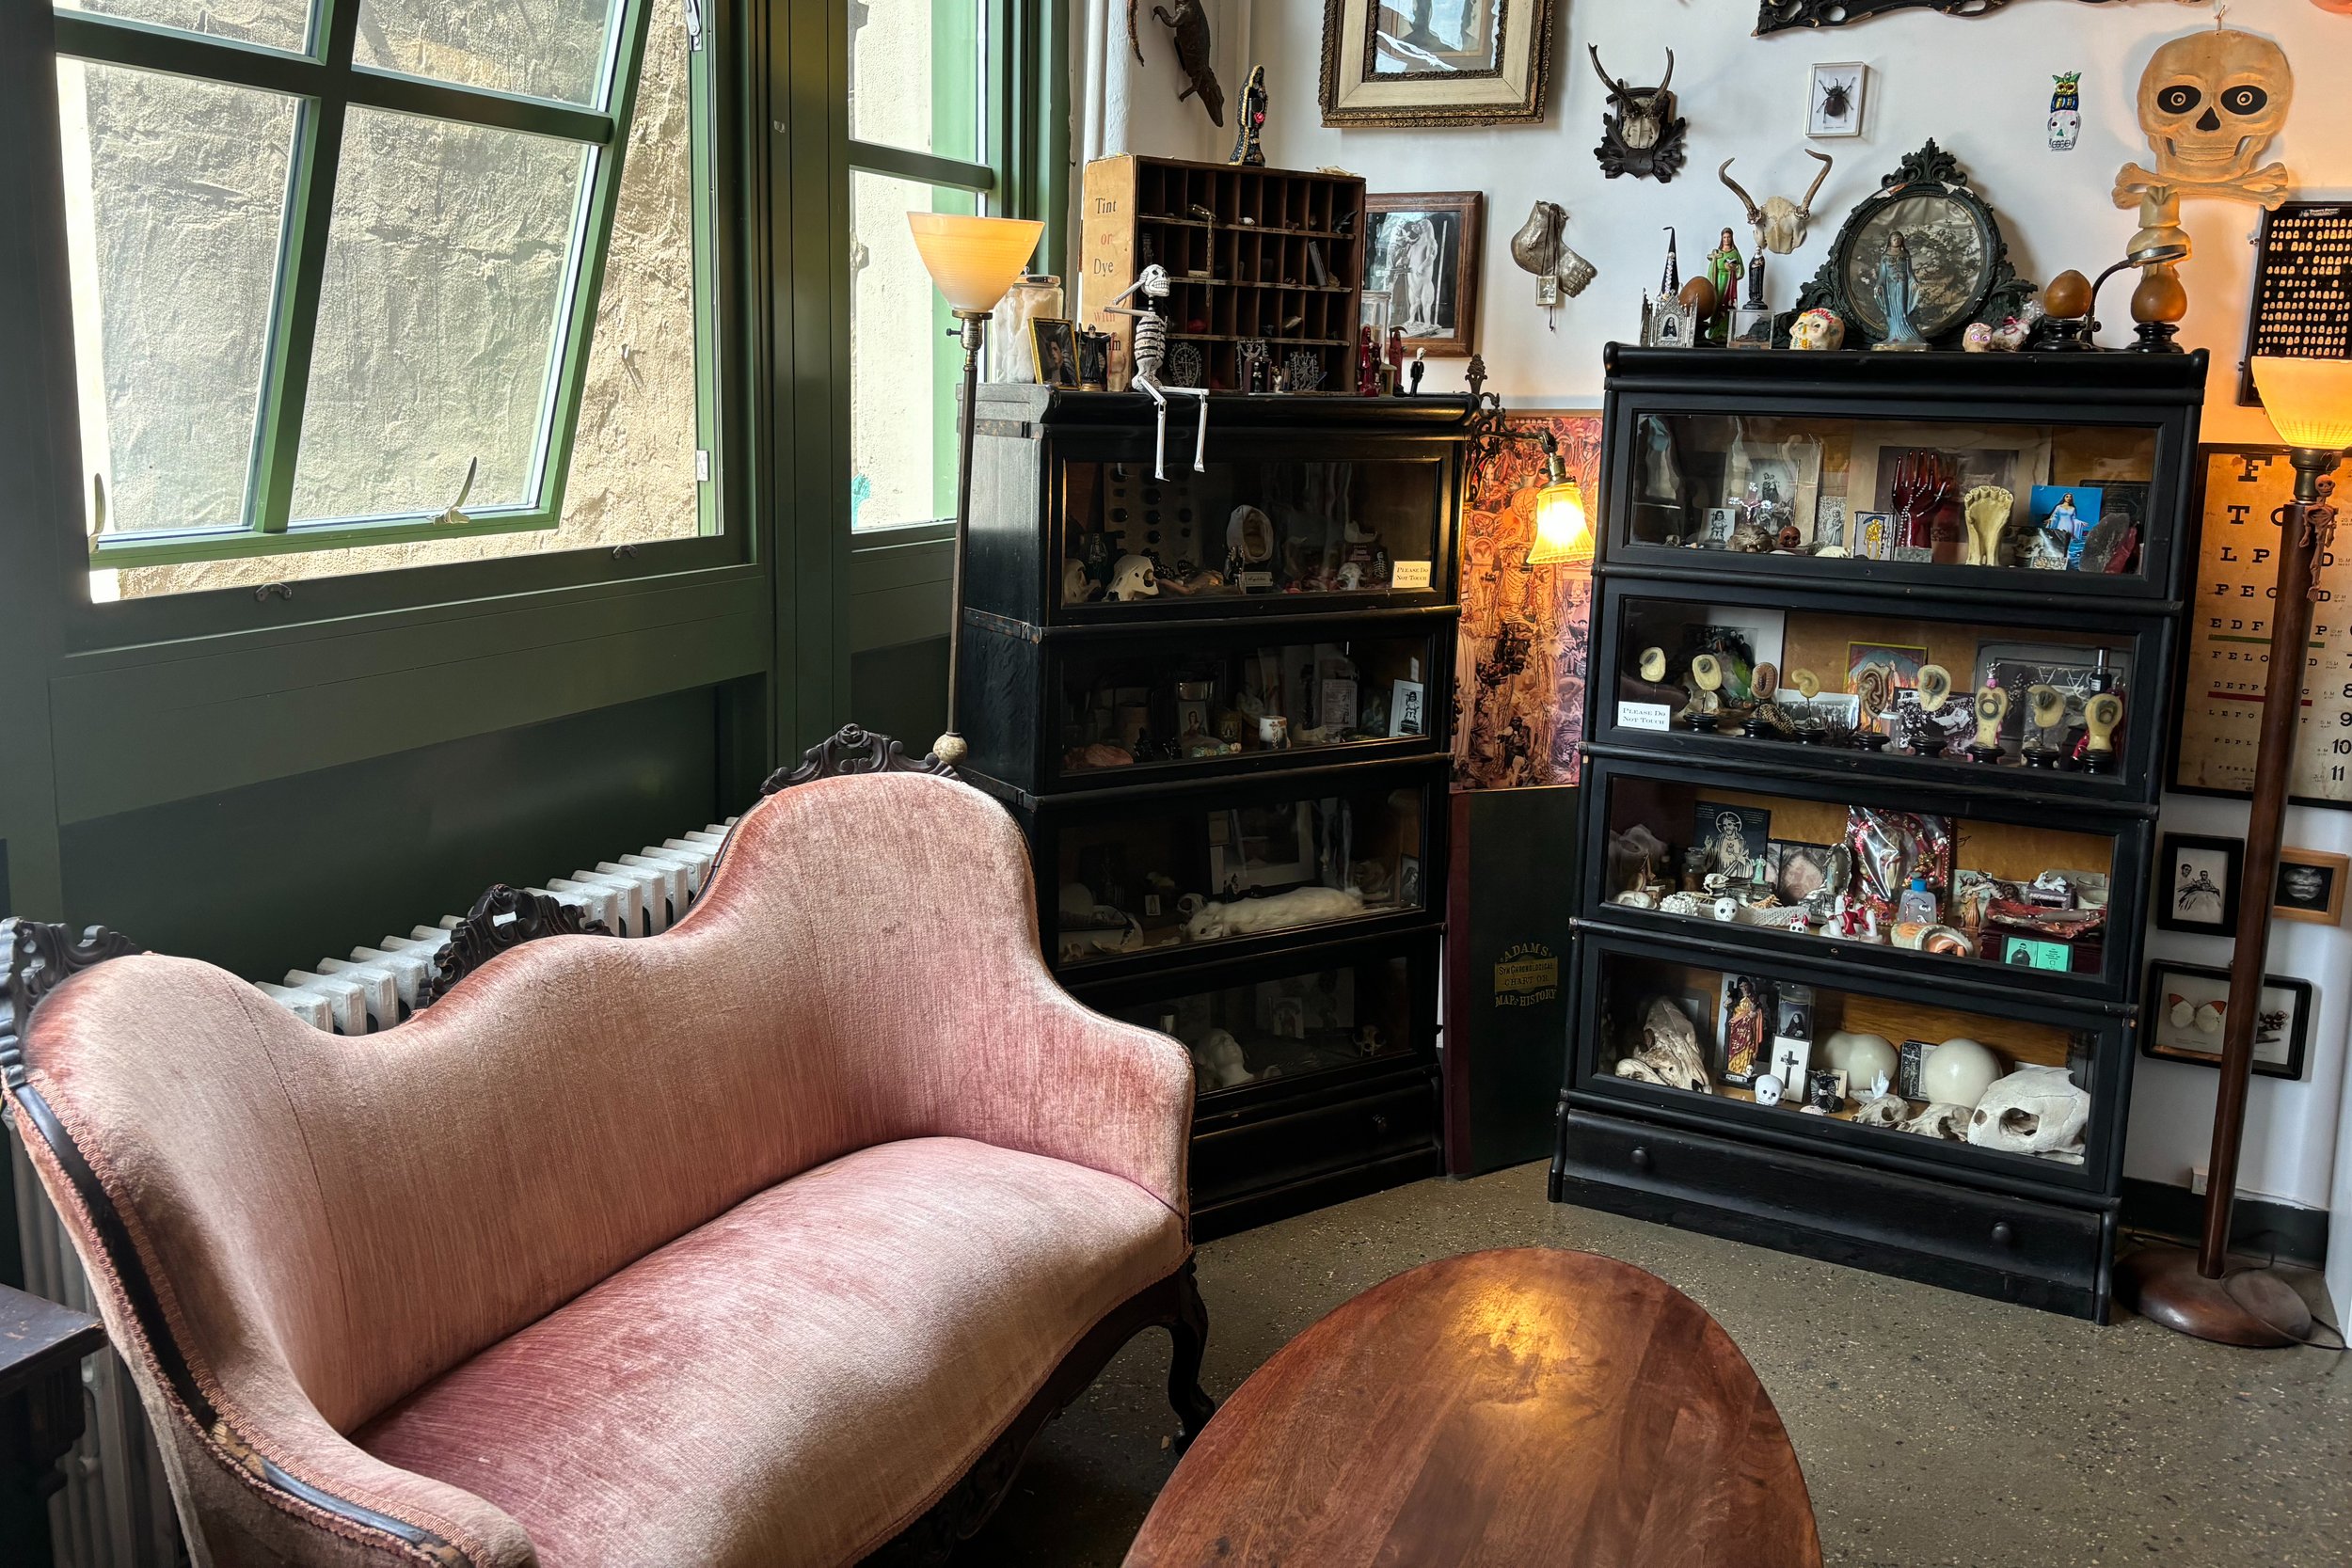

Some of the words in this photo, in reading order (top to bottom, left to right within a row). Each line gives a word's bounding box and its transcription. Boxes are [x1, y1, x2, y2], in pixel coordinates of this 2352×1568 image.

[1095, 197, 1117, 214] Tint
[1100, 233, 1113, 245] or
[1093, 258, 1114, 277] Dye
[2227, 504, 2250, 525] T
[2219, 546, 2237, 562] L
[2251, 548, 2270, 563] P
[2214, 583, 2230, 596] P
[2239, 585, 2255, 598] E
[1640, 717, 1664, 725] TOUCH
[2340, 711, 2352, 727] 9
[2332, 738, 2352, 754] 10
[2331, 765, 2345, 782] 11
[1505, 942, 1549, 961] ADAMS
[1495, 994, 1515, 1007] MAP
[1519, 989, 1557, 1006] HISTORY
